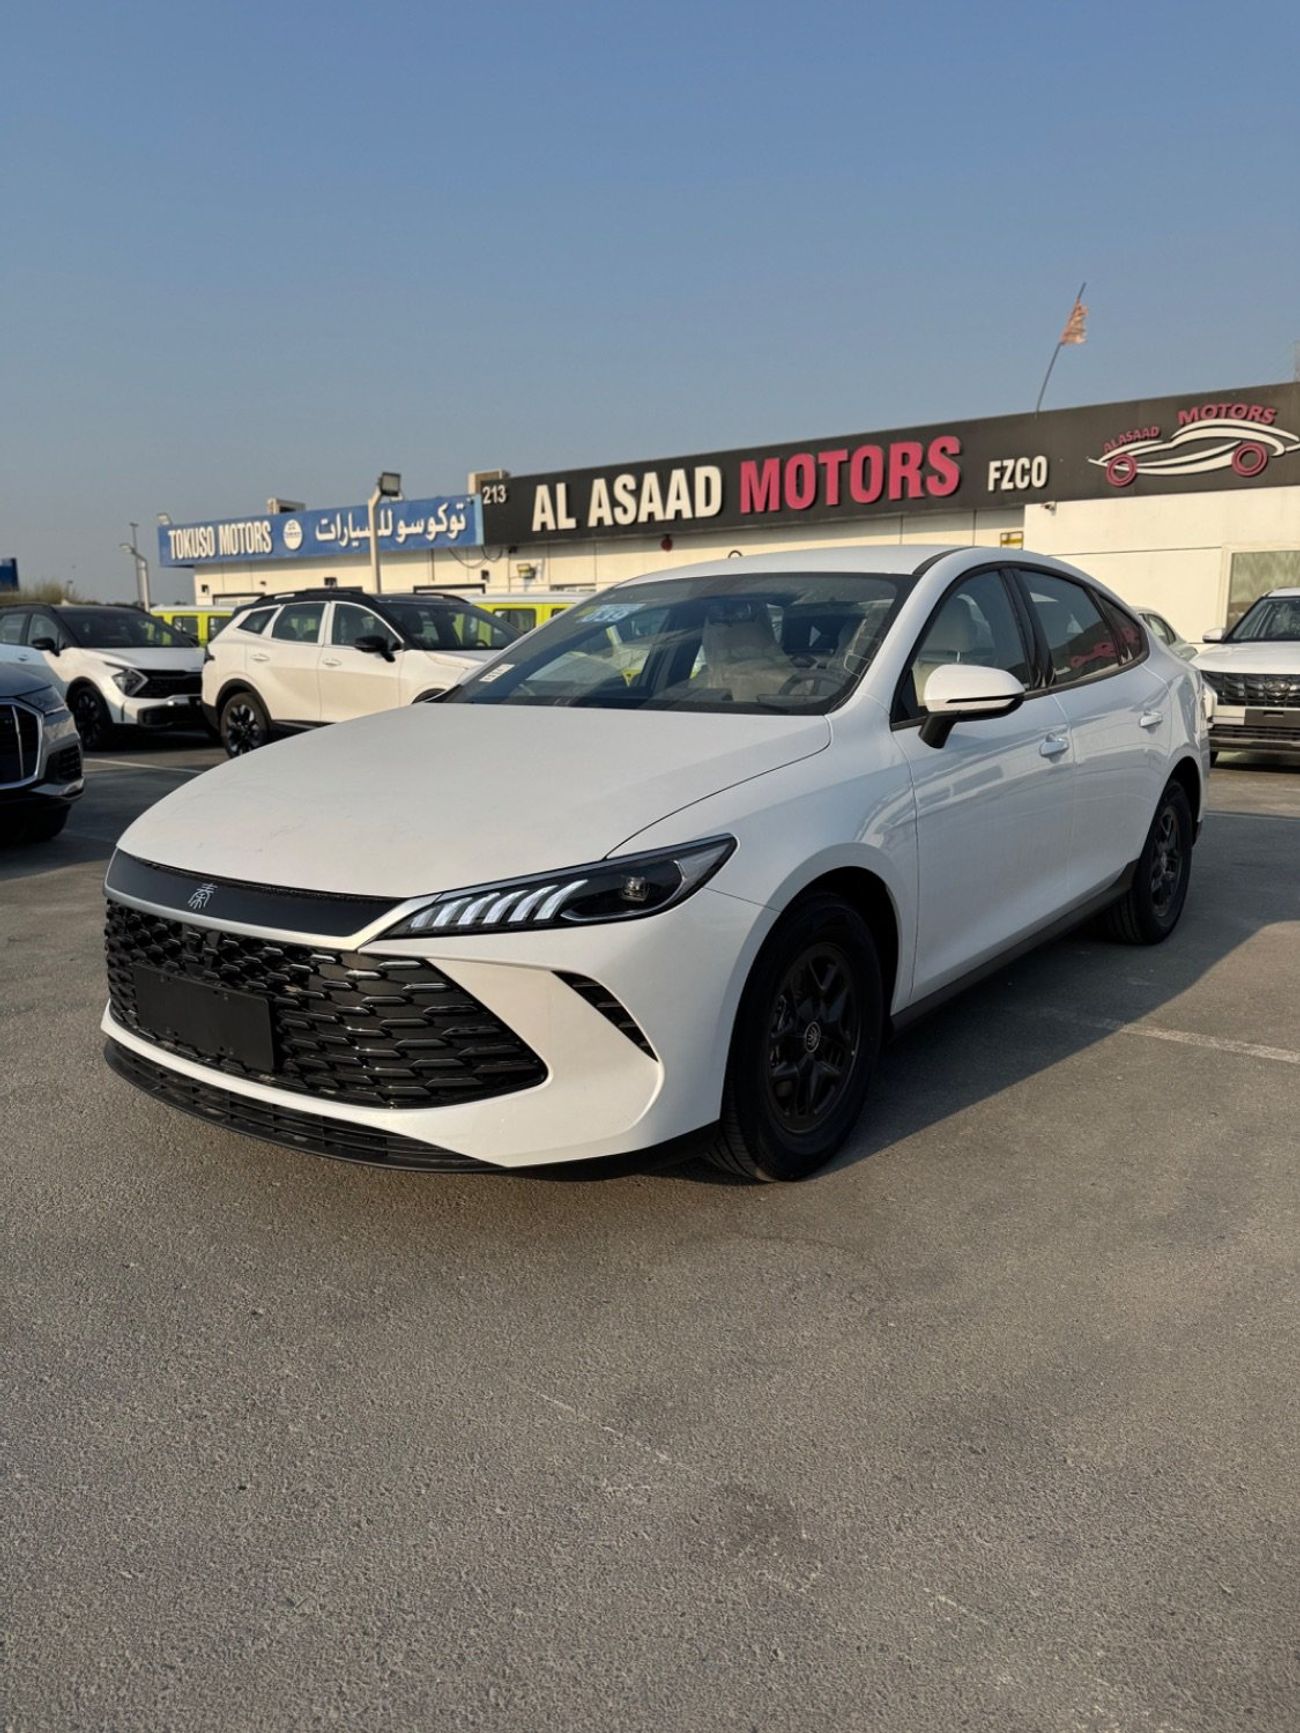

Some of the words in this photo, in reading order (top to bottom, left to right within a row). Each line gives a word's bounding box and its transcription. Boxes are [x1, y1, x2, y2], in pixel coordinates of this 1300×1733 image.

[1177, 403, 1277, 424] MOTORS
[482, 484, 507, 505] 213
[532, 483, 577, 532] AL
[587, 465, 722, 527] ASAAD
[740, 436, 961, 514] MOTORS
[988, 455, 1048, 491] FZCO
[168, 526, 216, 560] TOKUSO
[219, 520, 272, 556] MOTORS
